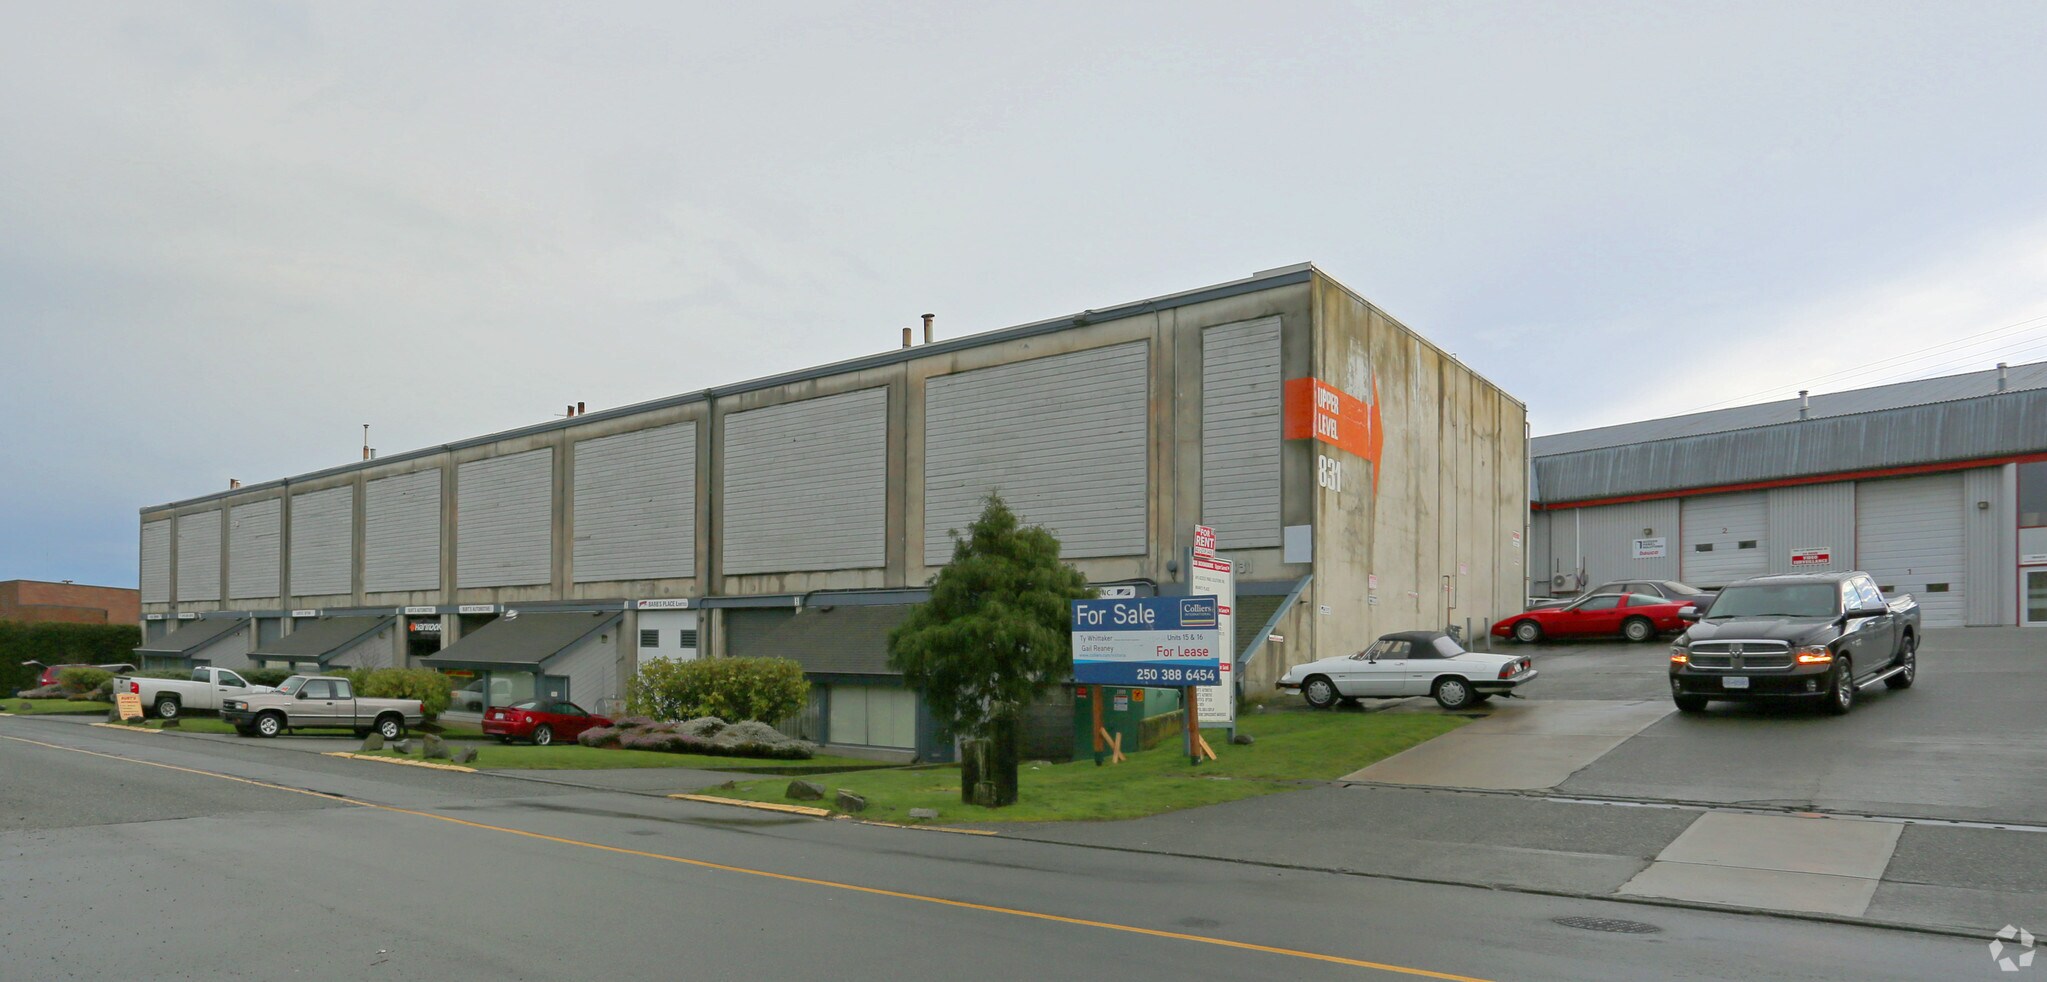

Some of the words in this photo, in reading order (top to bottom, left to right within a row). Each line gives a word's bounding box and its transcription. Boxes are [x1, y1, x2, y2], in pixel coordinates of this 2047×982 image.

[1317, 387, 1339, 415] UPPER
[1318, 412, 1339, 440] LEVEL
[1318, 454, 1341, 492] 831
[1200, 529, 1211, 537] FOR
[1196, 535, 1214, 548] RENT
[1077, 605, 1106, 625] For
[1113, 603, 1155, 625] Sale
[1184, 604, 1212, 613] Colliers
[1156, 646, 1174, 657] For
[1178, 646, 1209, 657] Lease
[1136, 669, 1158, 680] 250
[1161, 669, 1182, 681] 388
[1185, 669, 1215, 681] 6454
